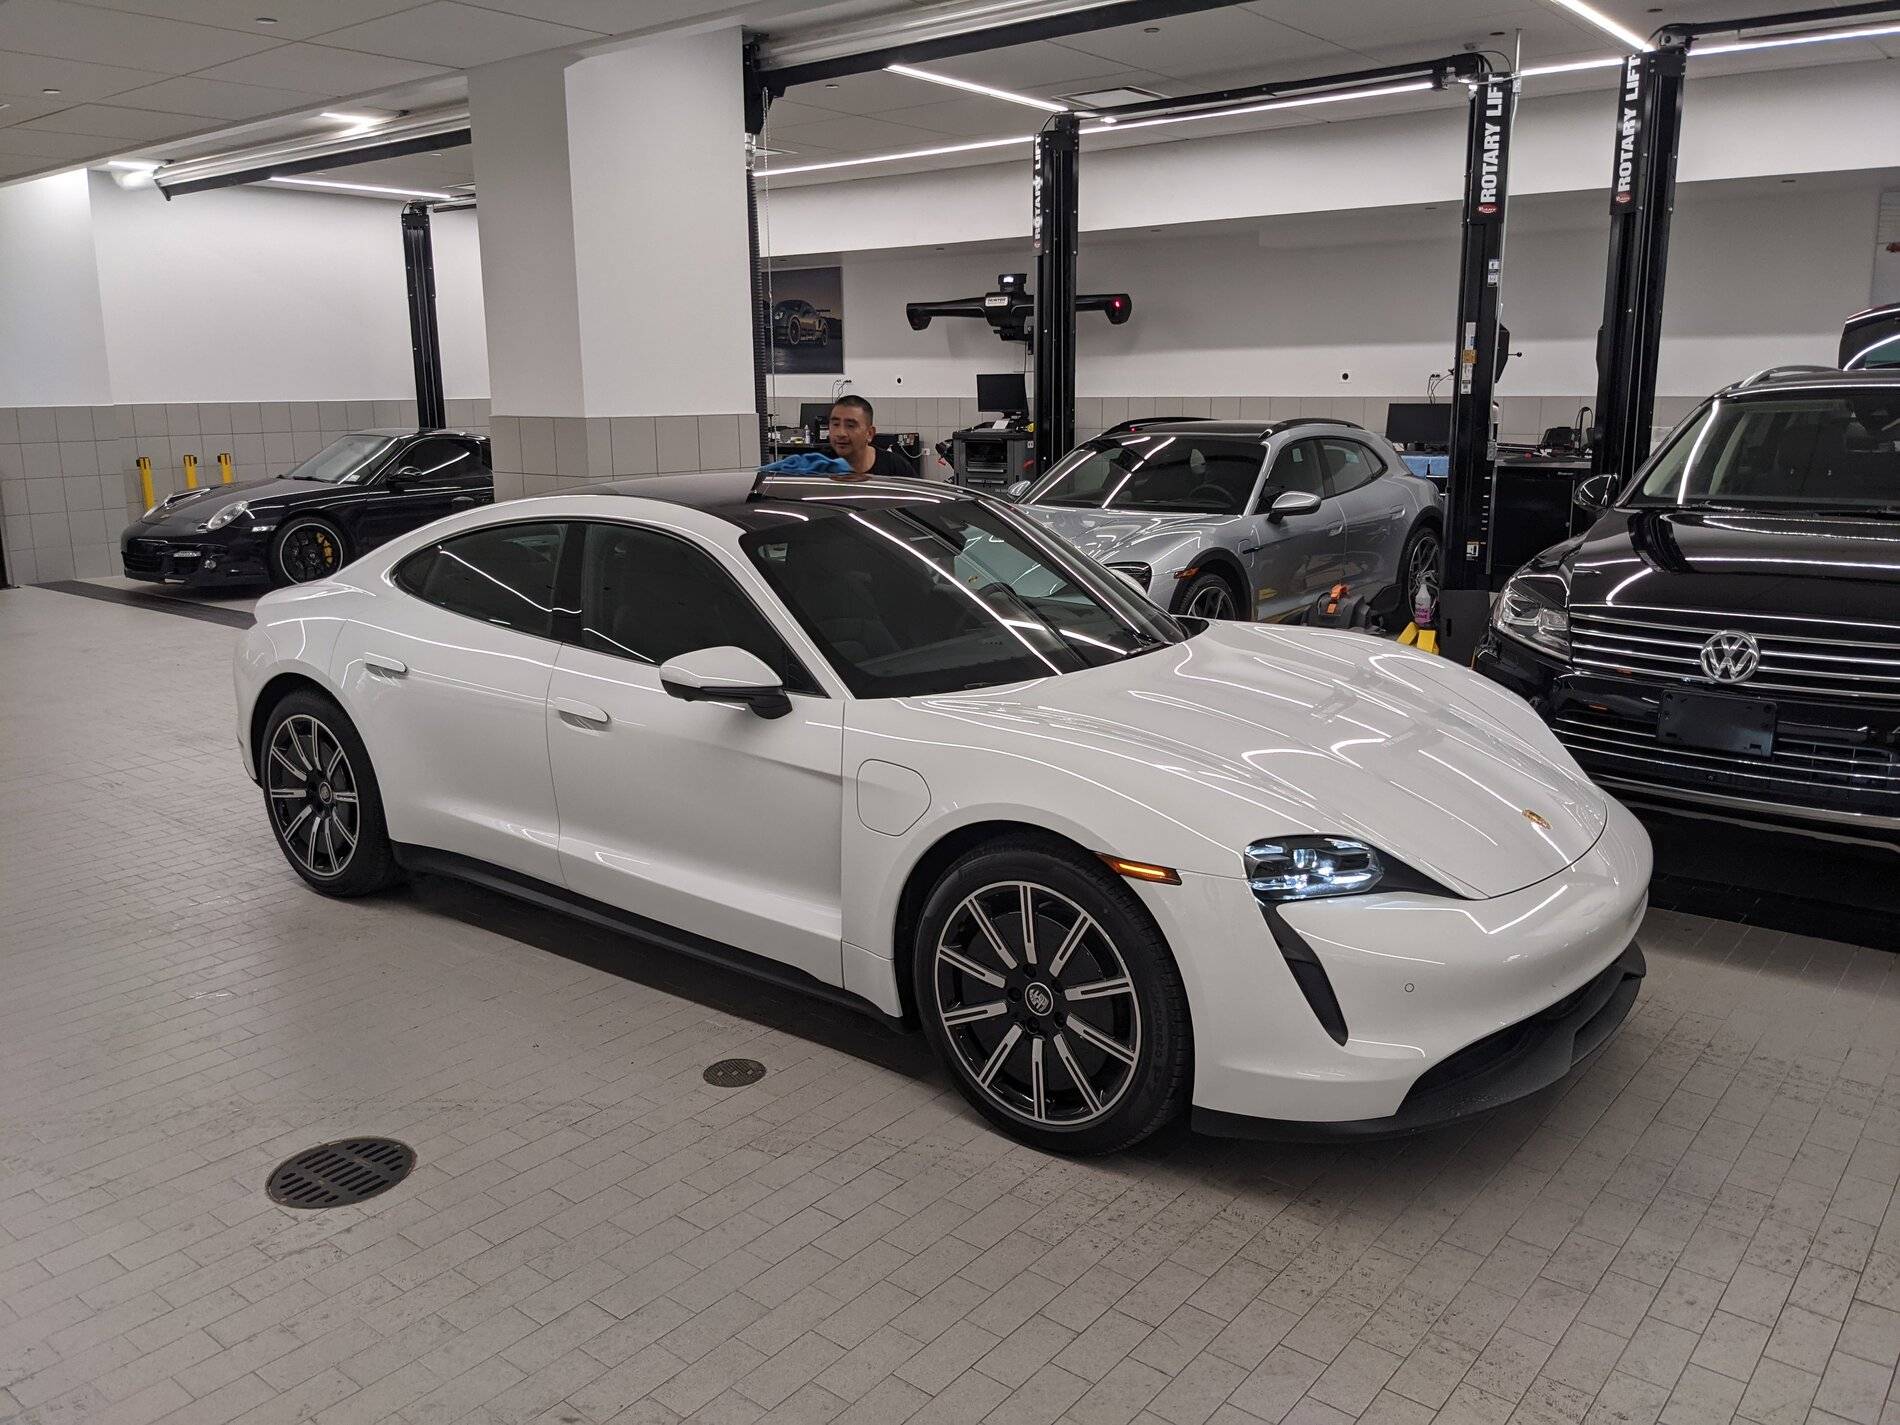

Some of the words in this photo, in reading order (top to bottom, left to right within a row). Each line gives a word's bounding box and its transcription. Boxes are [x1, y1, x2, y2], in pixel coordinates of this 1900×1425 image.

[1486, 74, 1503, 116] LIFT
[1625, 56, 1641, 101] LIFT
[1480, 123, 1502, 203] ROTARY
[1617, 108, 1637, 192] ROTARY
